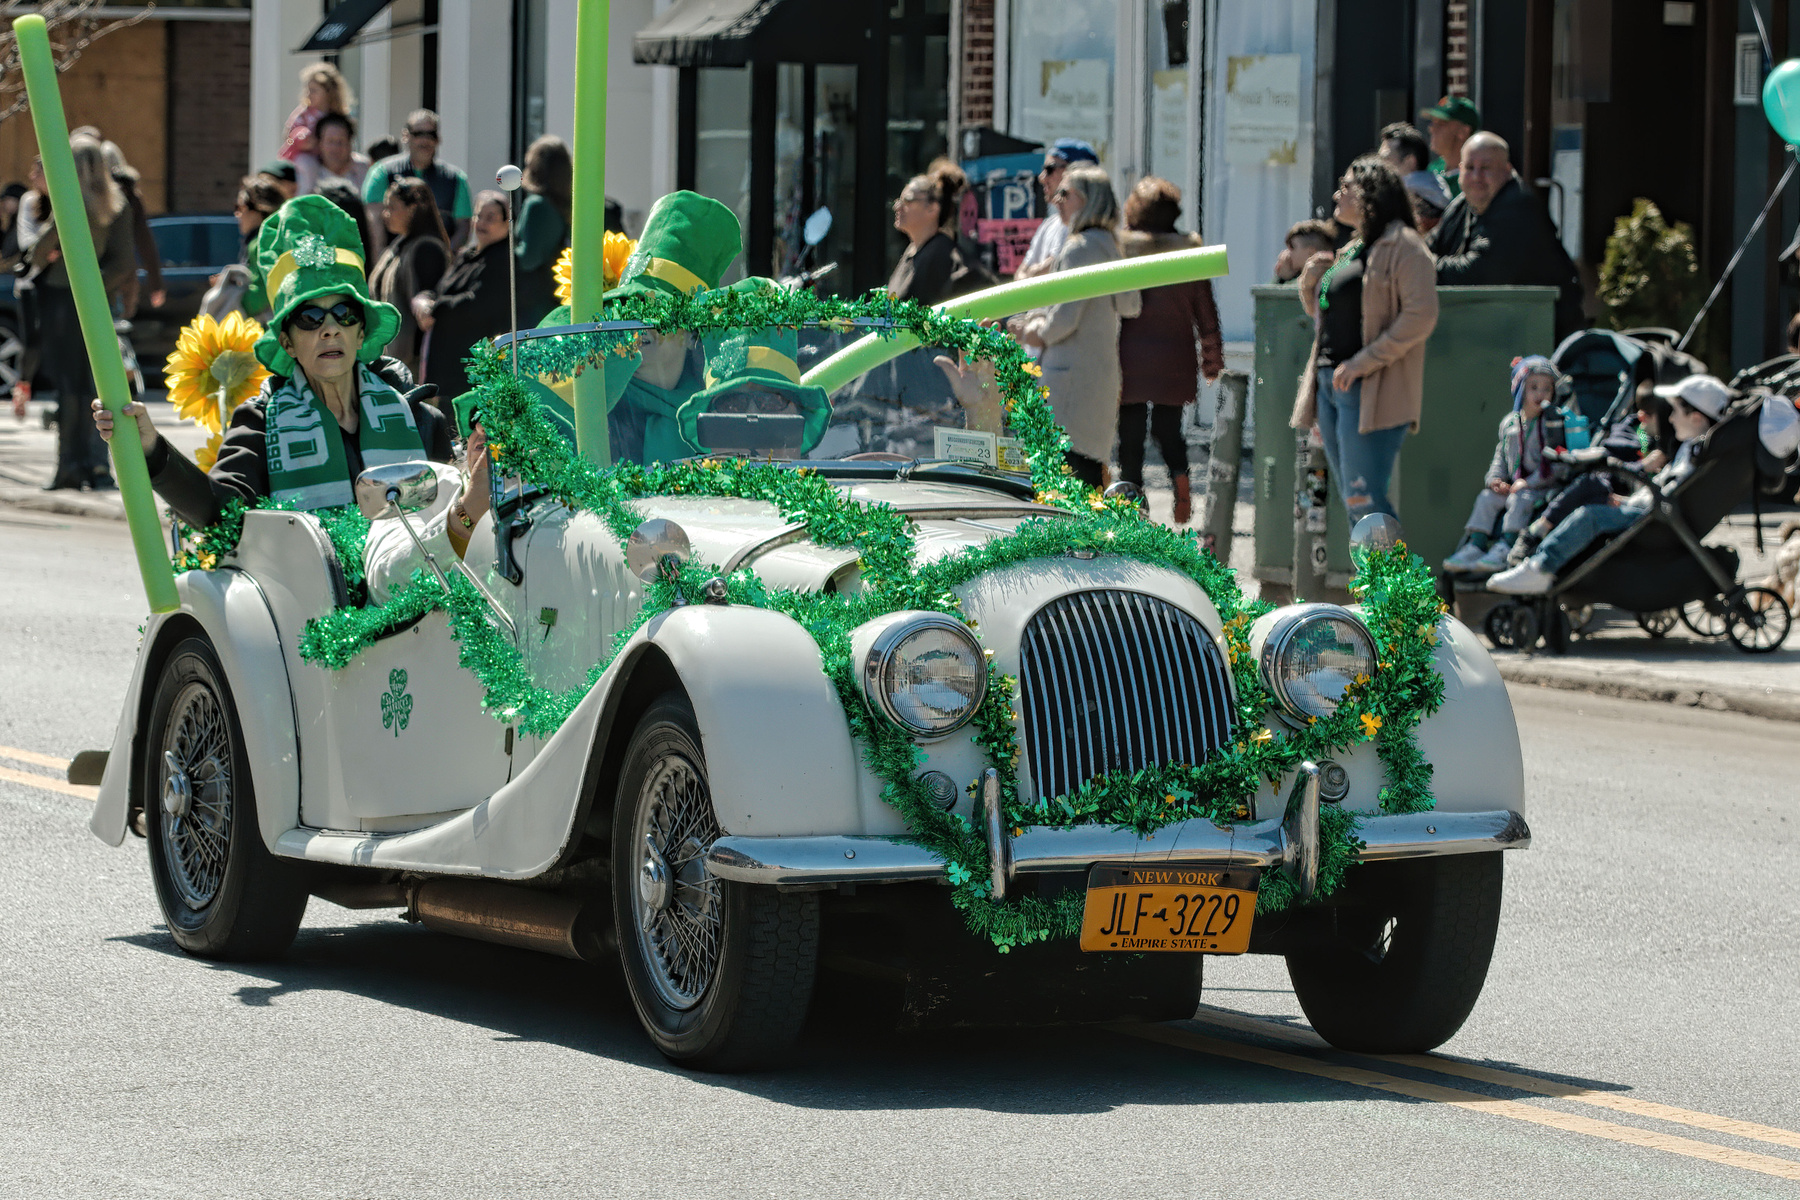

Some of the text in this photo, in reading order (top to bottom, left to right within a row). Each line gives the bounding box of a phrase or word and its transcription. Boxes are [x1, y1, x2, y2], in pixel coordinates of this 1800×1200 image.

[945, 444, 952, 454] 7
[977, 448, 991, 459] 23
[1132, 871, 1219, 886] NEW YORK
[1100, 892, 1240, 936] JLF 3229
[1121, 937, 1208, 949] EMPIRE STATE
